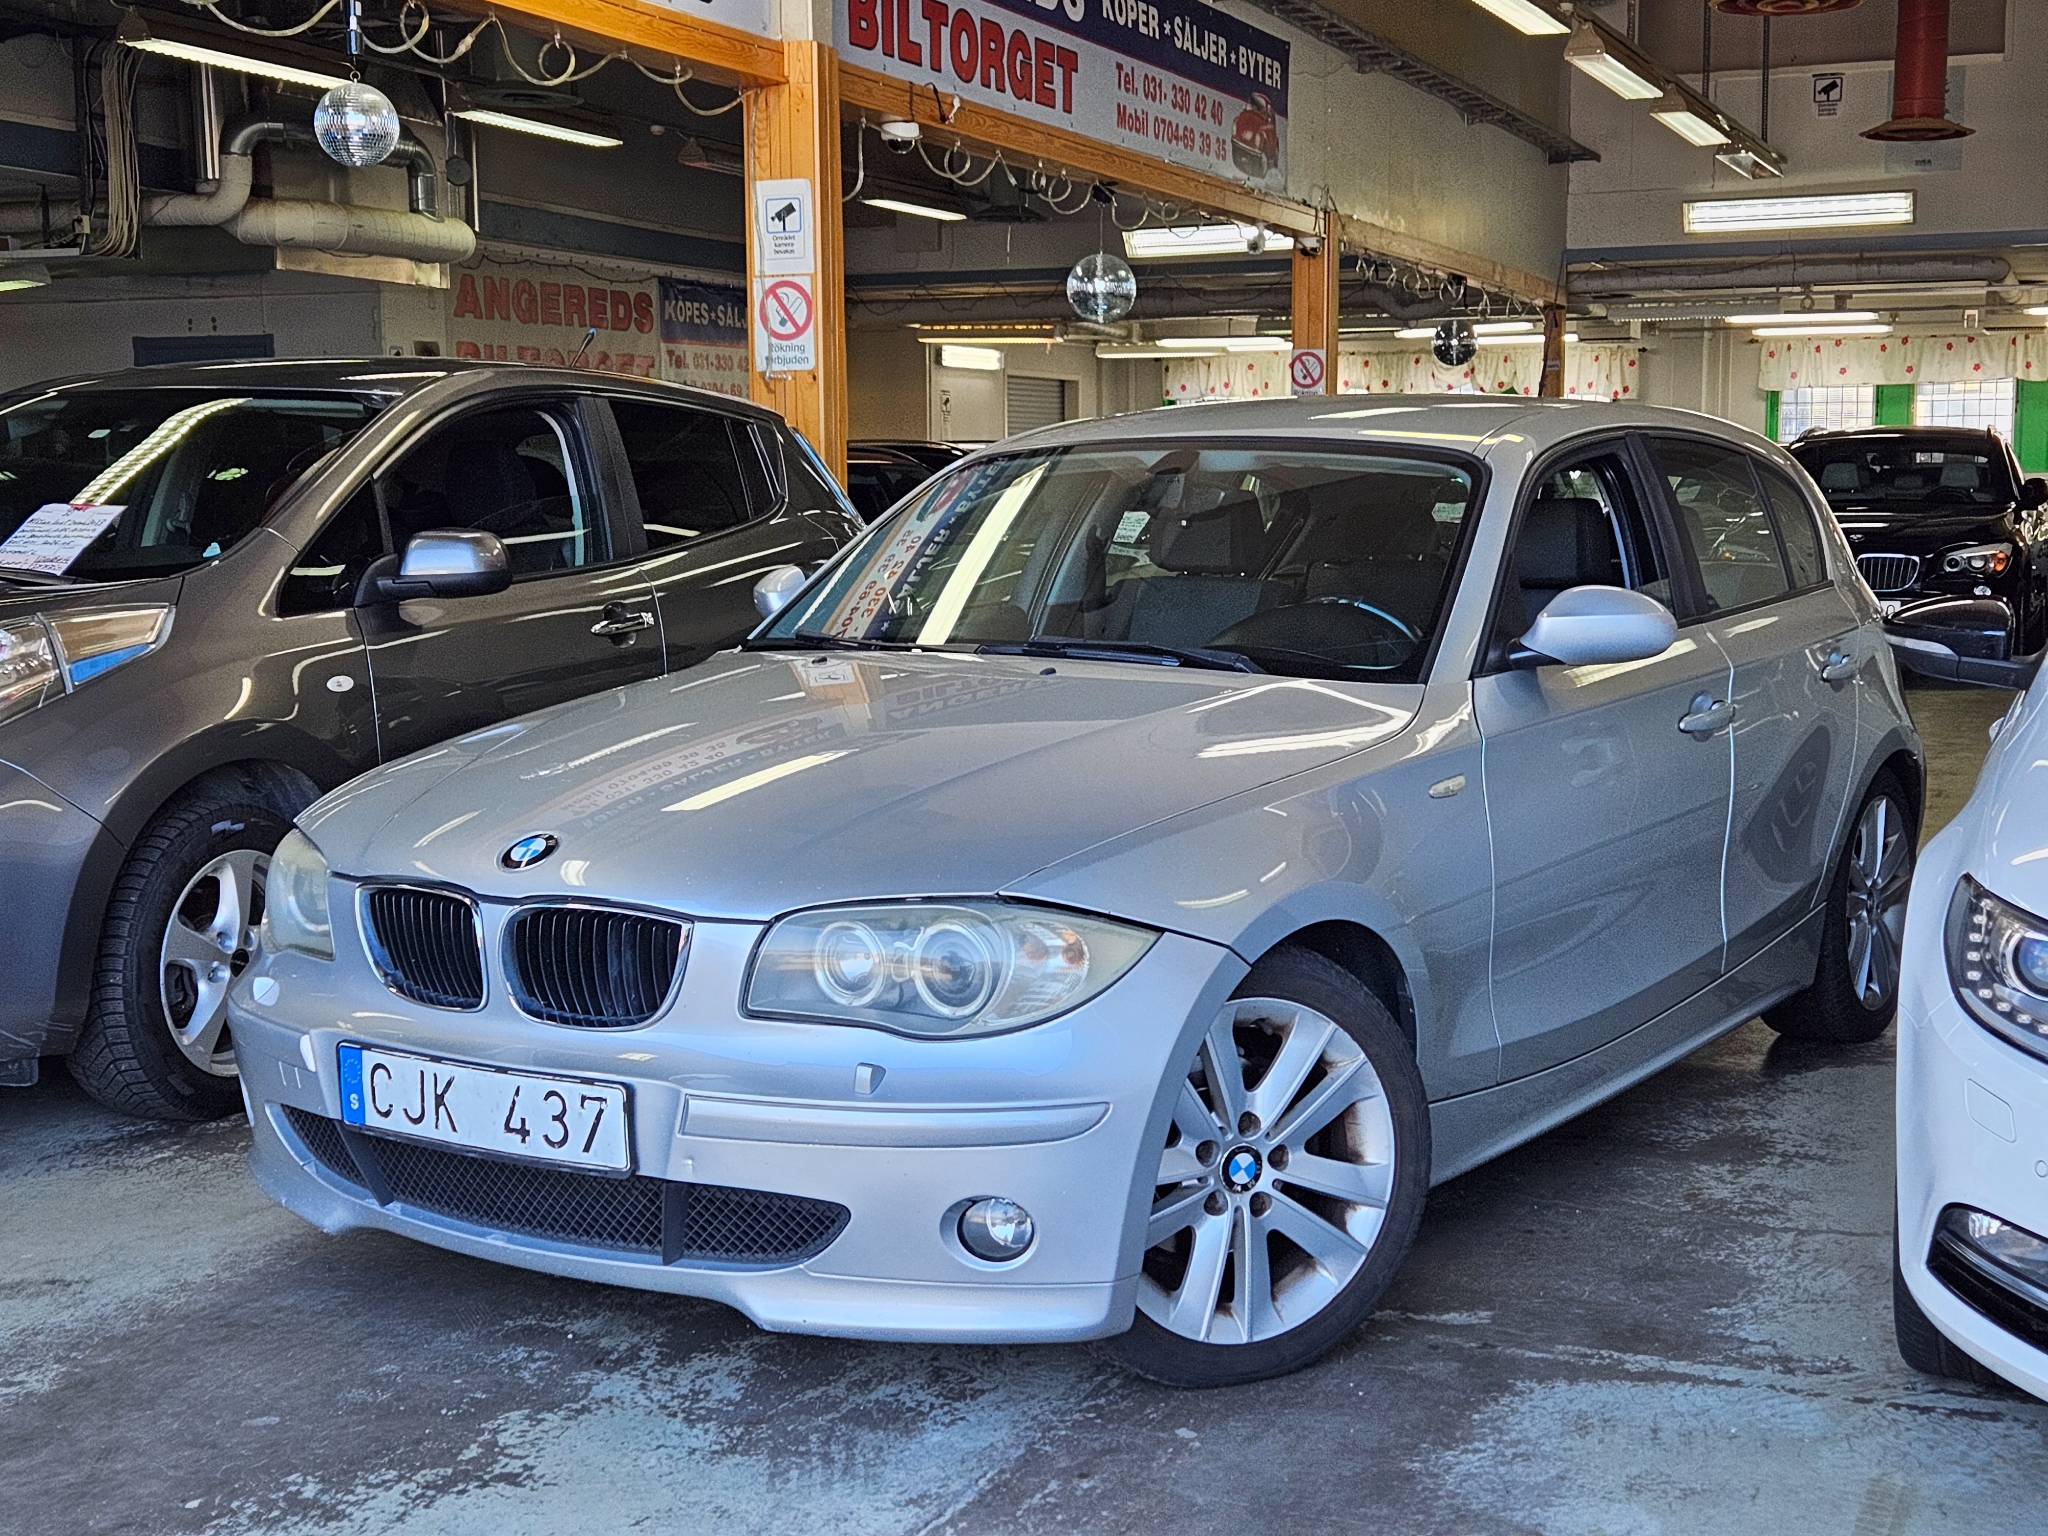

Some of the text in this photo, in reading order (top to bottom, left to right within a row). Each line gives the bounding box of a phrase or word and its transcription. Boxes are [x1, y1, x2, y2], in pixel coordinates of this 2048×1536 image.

[848, 0, 1079, 114] BILTORGET
[1174, 15, 1227, 68] SÄLJER
[1238, 45, 1282, 91] BYTER
[1115, 61, 1138, 97] Tel.
[1171, 83, 1191, 115] 330
[1194, 92, 1207, 122] 42
[1210, 99, 1224, 127] 40
[1116, 102, 1227, 162] Mobil 0704-69 39 35
[453, 273, 655, 334] ANGEREDS
[664, 295, 709, 326] KÖPES
[349, 1092, 360, 1111] S
[370, 1062, 608, 1154] CJK 437
